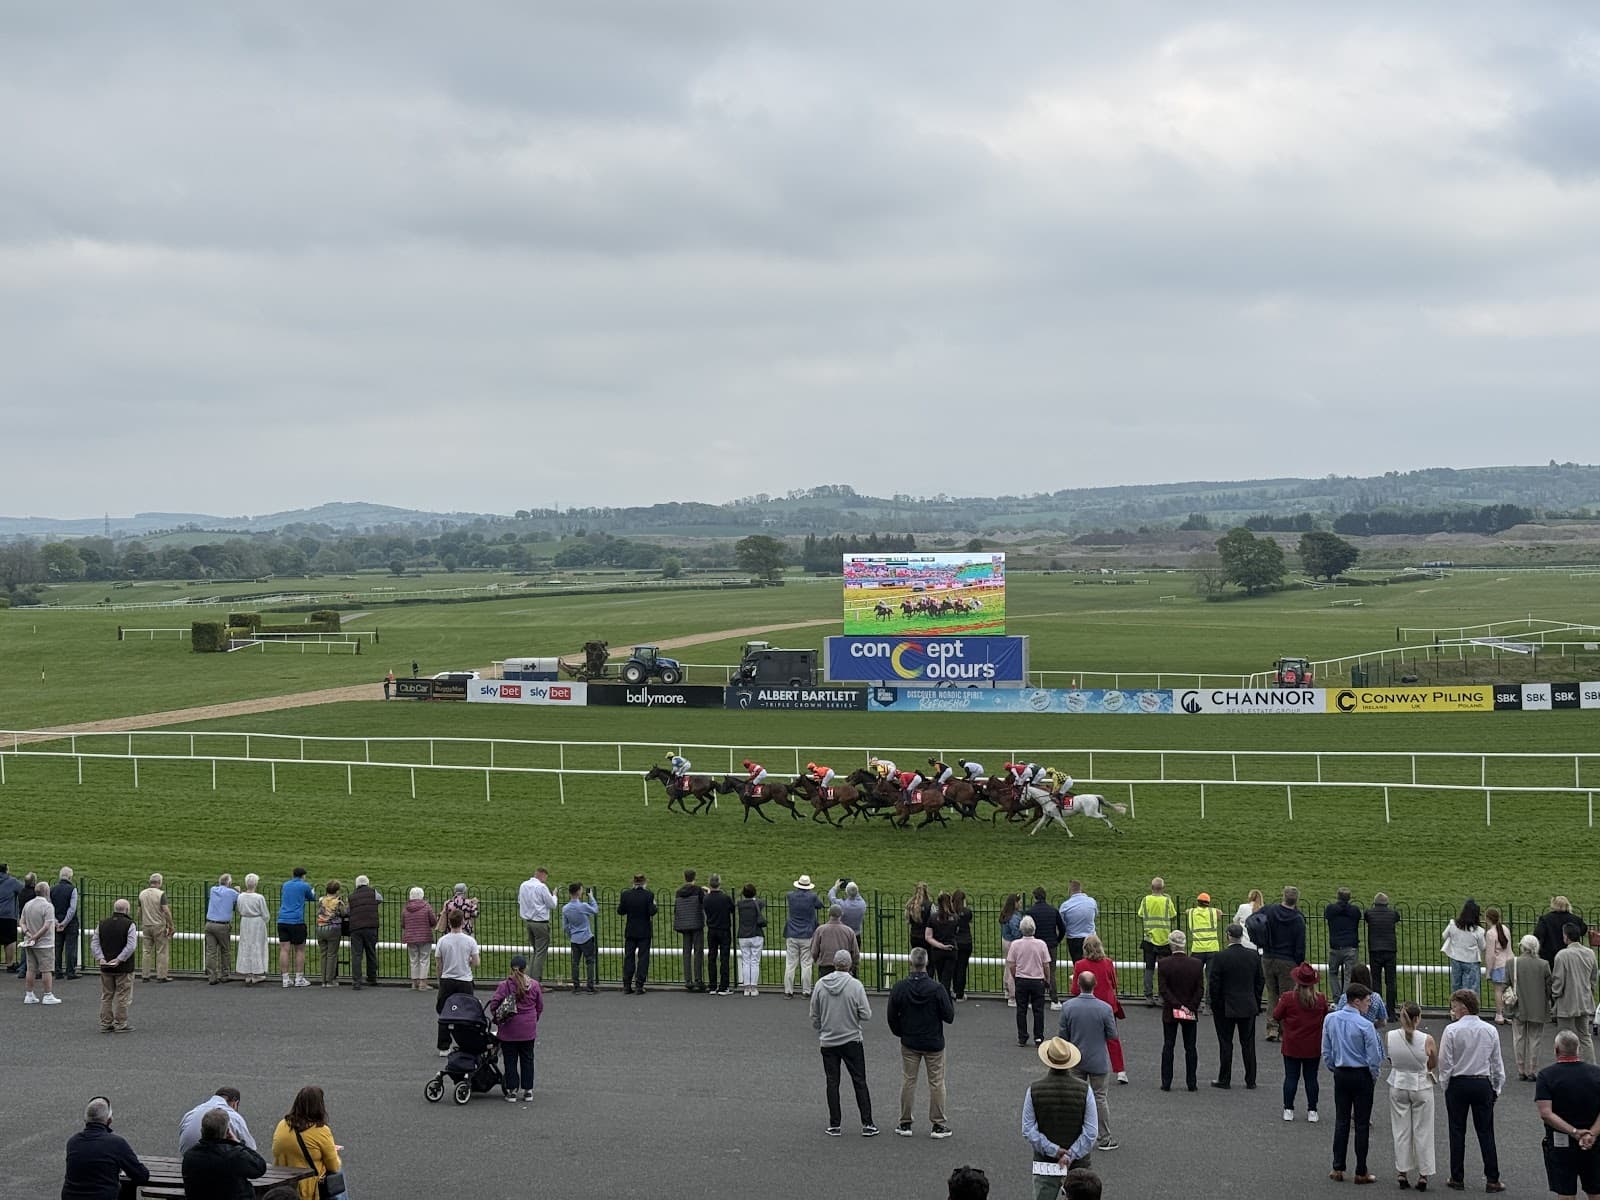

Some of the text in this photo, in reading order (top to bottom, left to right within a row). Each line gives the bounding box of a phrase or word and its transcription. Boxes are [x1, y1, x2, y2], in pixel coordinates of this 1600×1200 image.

[480, 685, 520, 697] sky bet
[530, 687, 569, 699] sky bet
[757, 690, 858, 701] ALBERT BARTLETT
[906, 690, 937, 699] DISCOVER
[938, 691, 961, 699] NORDIC
[1211, 690, 1315, 705] CHANNOR
